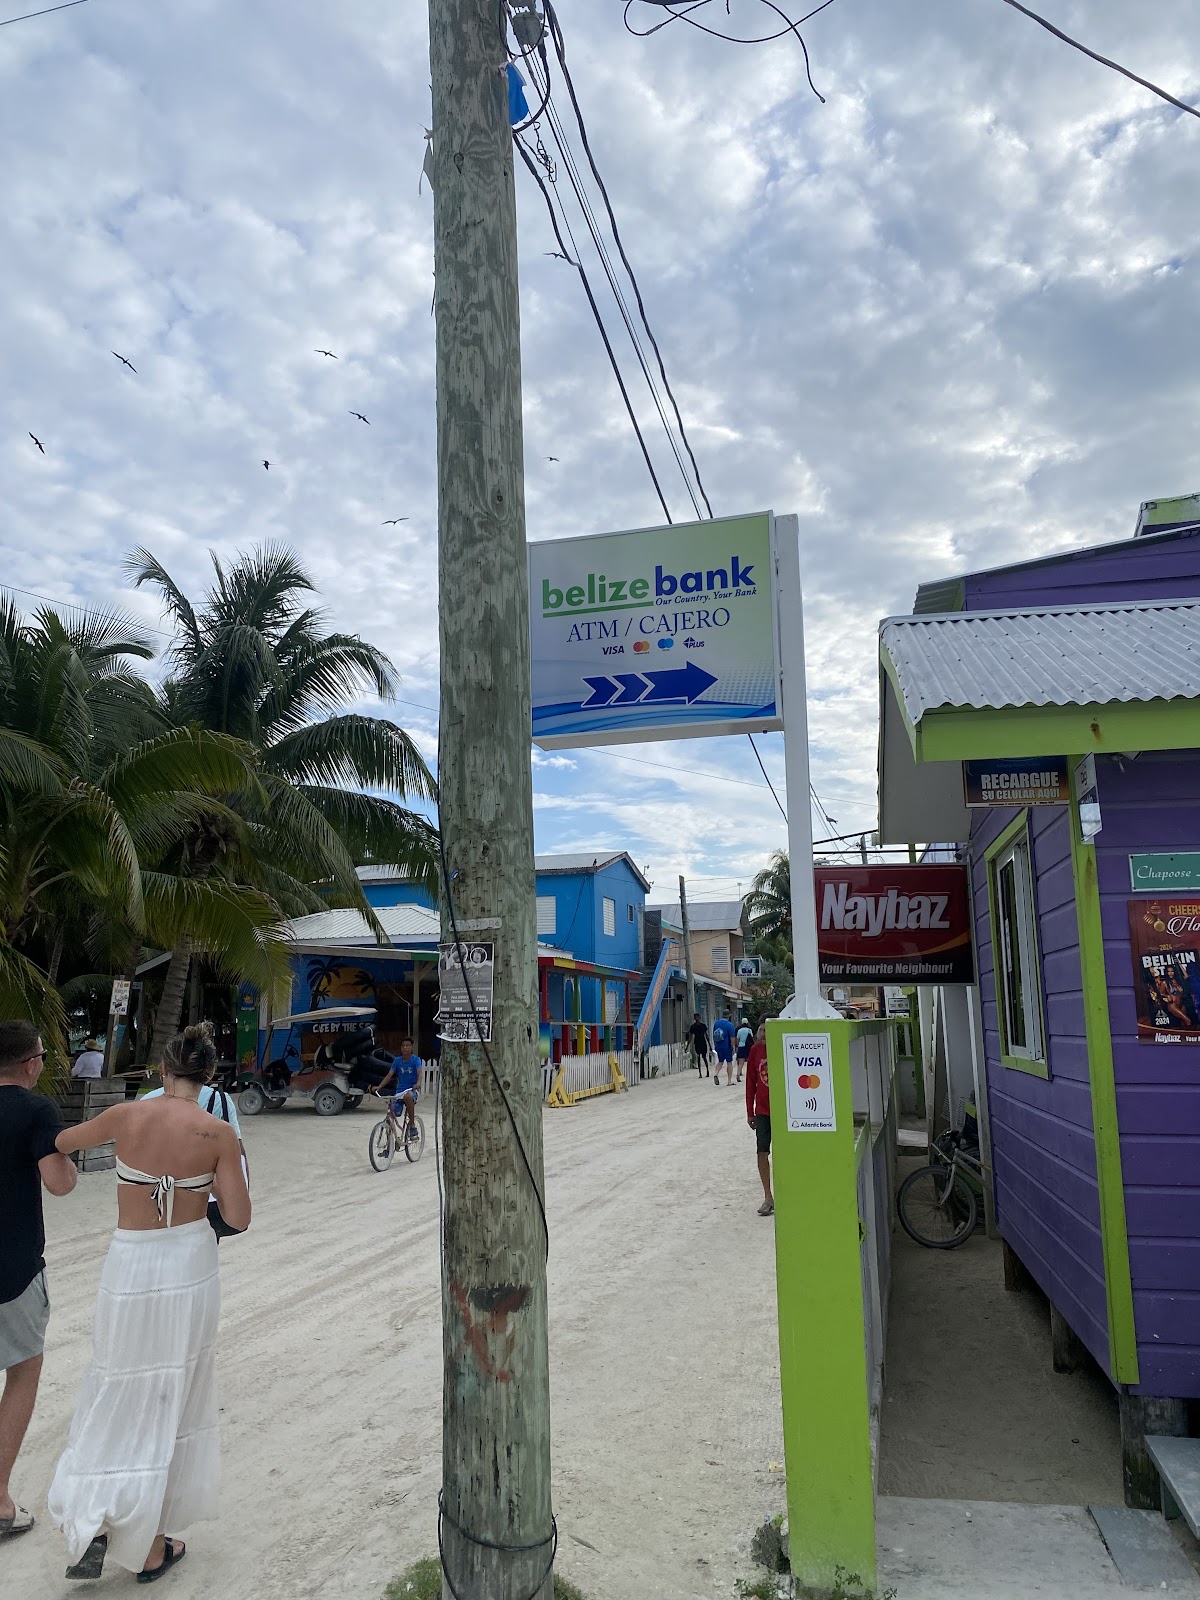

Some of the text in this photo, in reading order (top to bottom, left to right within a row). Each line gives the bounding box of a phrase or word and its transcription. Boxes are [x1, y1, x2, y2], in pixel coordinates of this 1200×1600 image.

[542, 555, 757, 610] belize bank
[655, 586, 757, 606] Our Country. Your Bank
[566, 607, 731, 643] ATM / CAJERO
[601, 645, 625, 655] VISA
[688, 640, 705, 648] PLUS
[981, 771, 1059, 790] RECARGUE
[981, 790, 995, 801] SU
[996, 789, 1036, 800] CELULAR
[1136, 865, 1192, 881] Chapoose
[821, 883, 950, 937] Naybaz
[1159, 943, 1173, 951] 2024
[822, 963, 953, 975] Your Favourite Neighbour!
[1155, 1017, 1170, 1025] 2024
[330, 1022, 340, 1033] BY
[341, 1022, 357, 1032] THE
[1155, 1032, 1181, 1044] Naybaz
[794, 1056, 822, 1067] VISA
